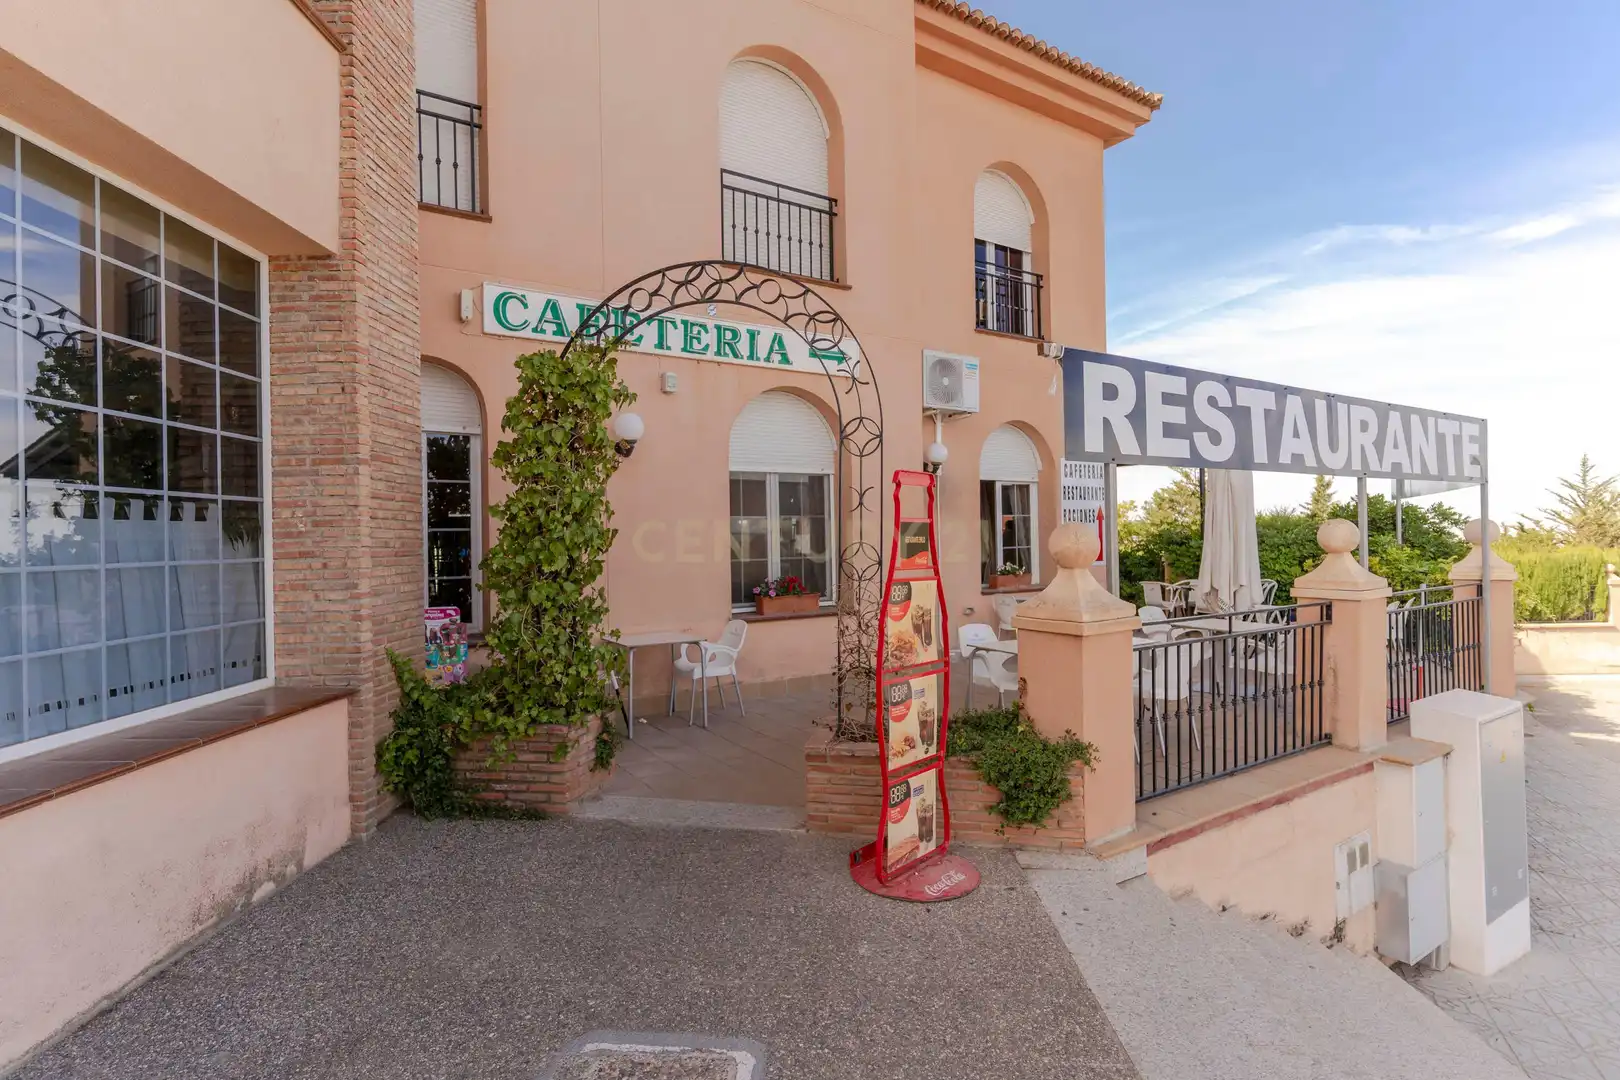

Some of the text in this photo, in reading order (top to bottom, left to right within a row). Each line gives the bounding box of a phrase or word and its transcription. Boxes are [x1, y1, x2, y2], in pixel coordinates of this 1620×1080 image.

[493, 291, 794, 366] CAFETERIA
[1082, 360, 1481, 477] RESTAURANTE
[1063, 463, 1104, 480] CAFETERIA
[1062, 485, 1105, 501] RESTAURANTE
[1063, 508, 1096, 523] RACIONES
